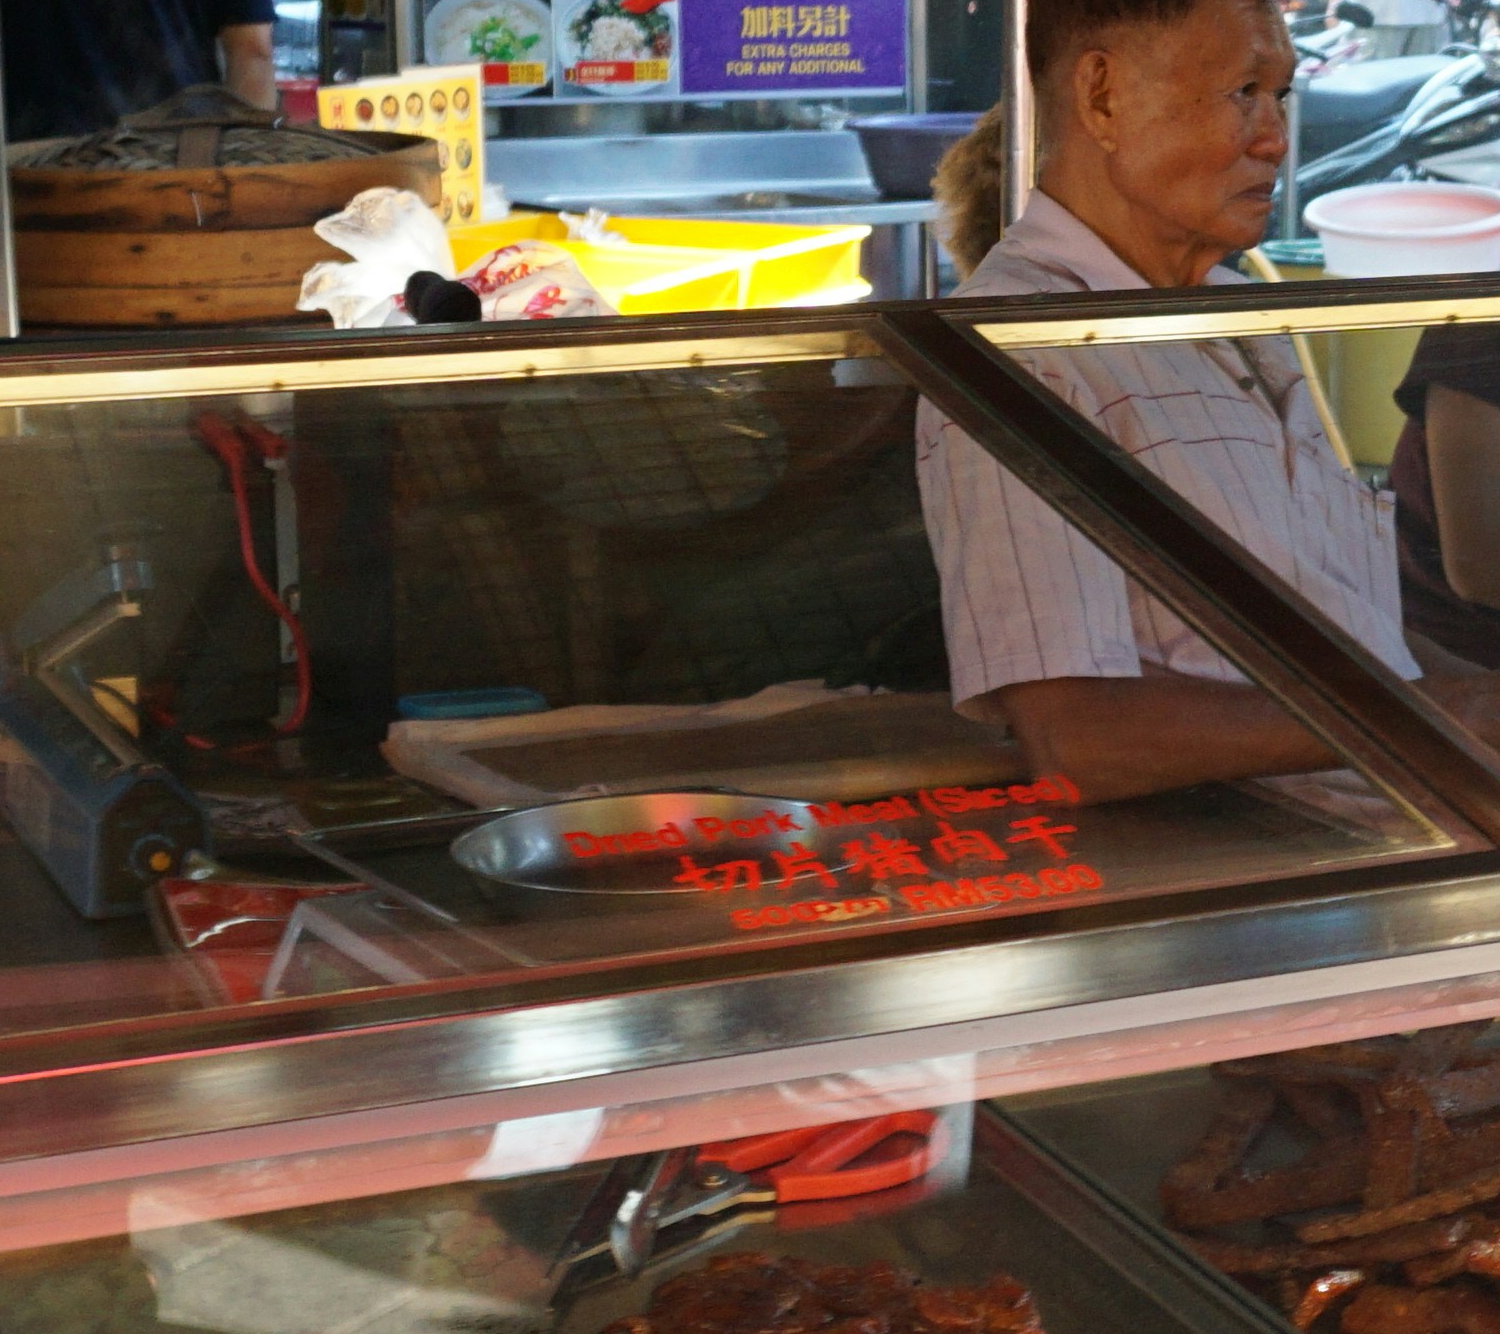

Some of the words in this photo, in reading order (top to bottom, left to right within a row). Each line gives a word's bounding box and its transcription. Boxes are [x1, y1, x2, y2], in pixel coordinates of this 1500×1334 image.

[740, 4, 852, 38] 加料另計
[726, 60, 754, 75] FOR
[756, 60, 786, 74] ANY
[789, 57, 865, 74] ADDITIONAL
[741, 43, 786, 59] EXTRA
[789, 42, 851, 58] CHARGES
[563, 819, 689, 859] Dried
[693, 806, 804, 844] Pork
[806, 793, 920, 829] Meat
[672, 814, 1079, 896] 切片猪肉干
[728, 894, 892, 932] 500gm
[897, 863, 1105, 913] RM53.00
